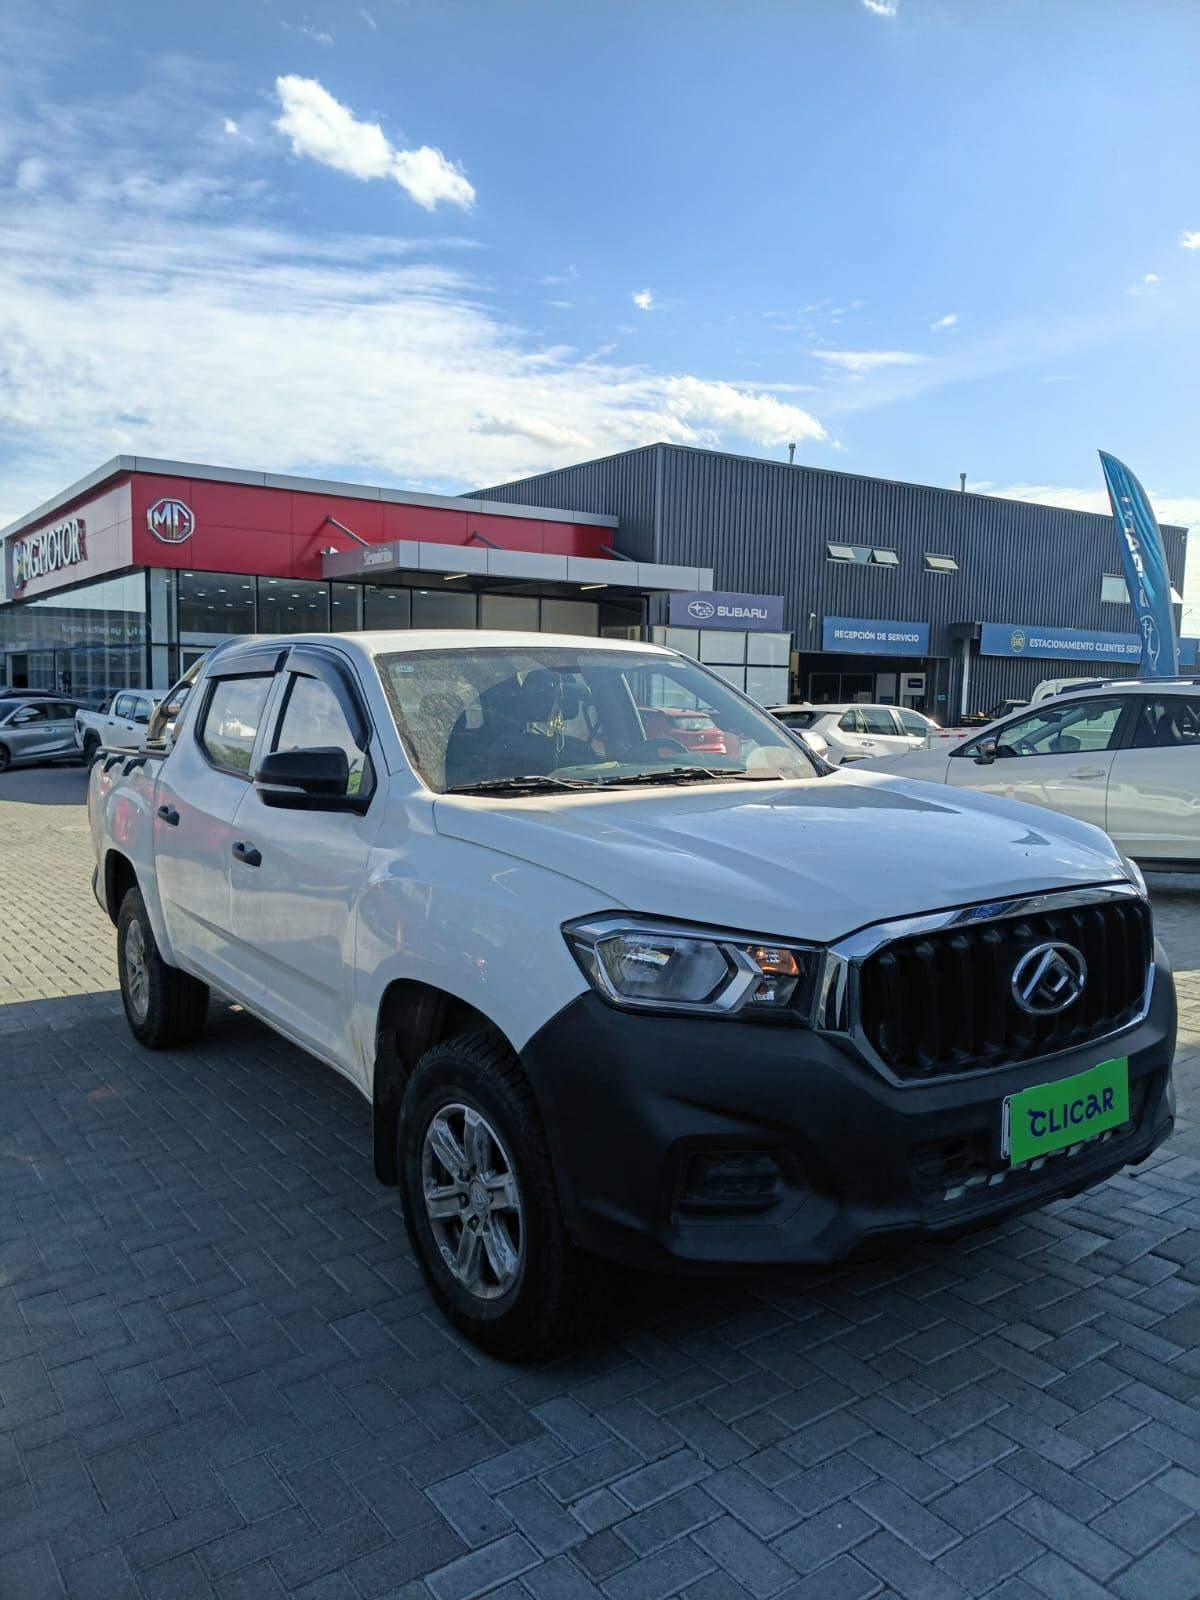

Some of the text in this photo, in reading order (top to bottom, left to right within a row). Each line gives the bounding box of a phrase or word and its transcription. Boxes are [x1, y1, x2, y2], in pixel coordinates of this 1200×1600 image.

[151, 502, 191, 541] MG
[717, 606, 768, 619] SUBARU
[834, 629, 920, 643] RECEPCIÓN DE SERVICIO
[1029, 638, 1143, 654] ESTACIONAMIENTO CLIENTES SERV
